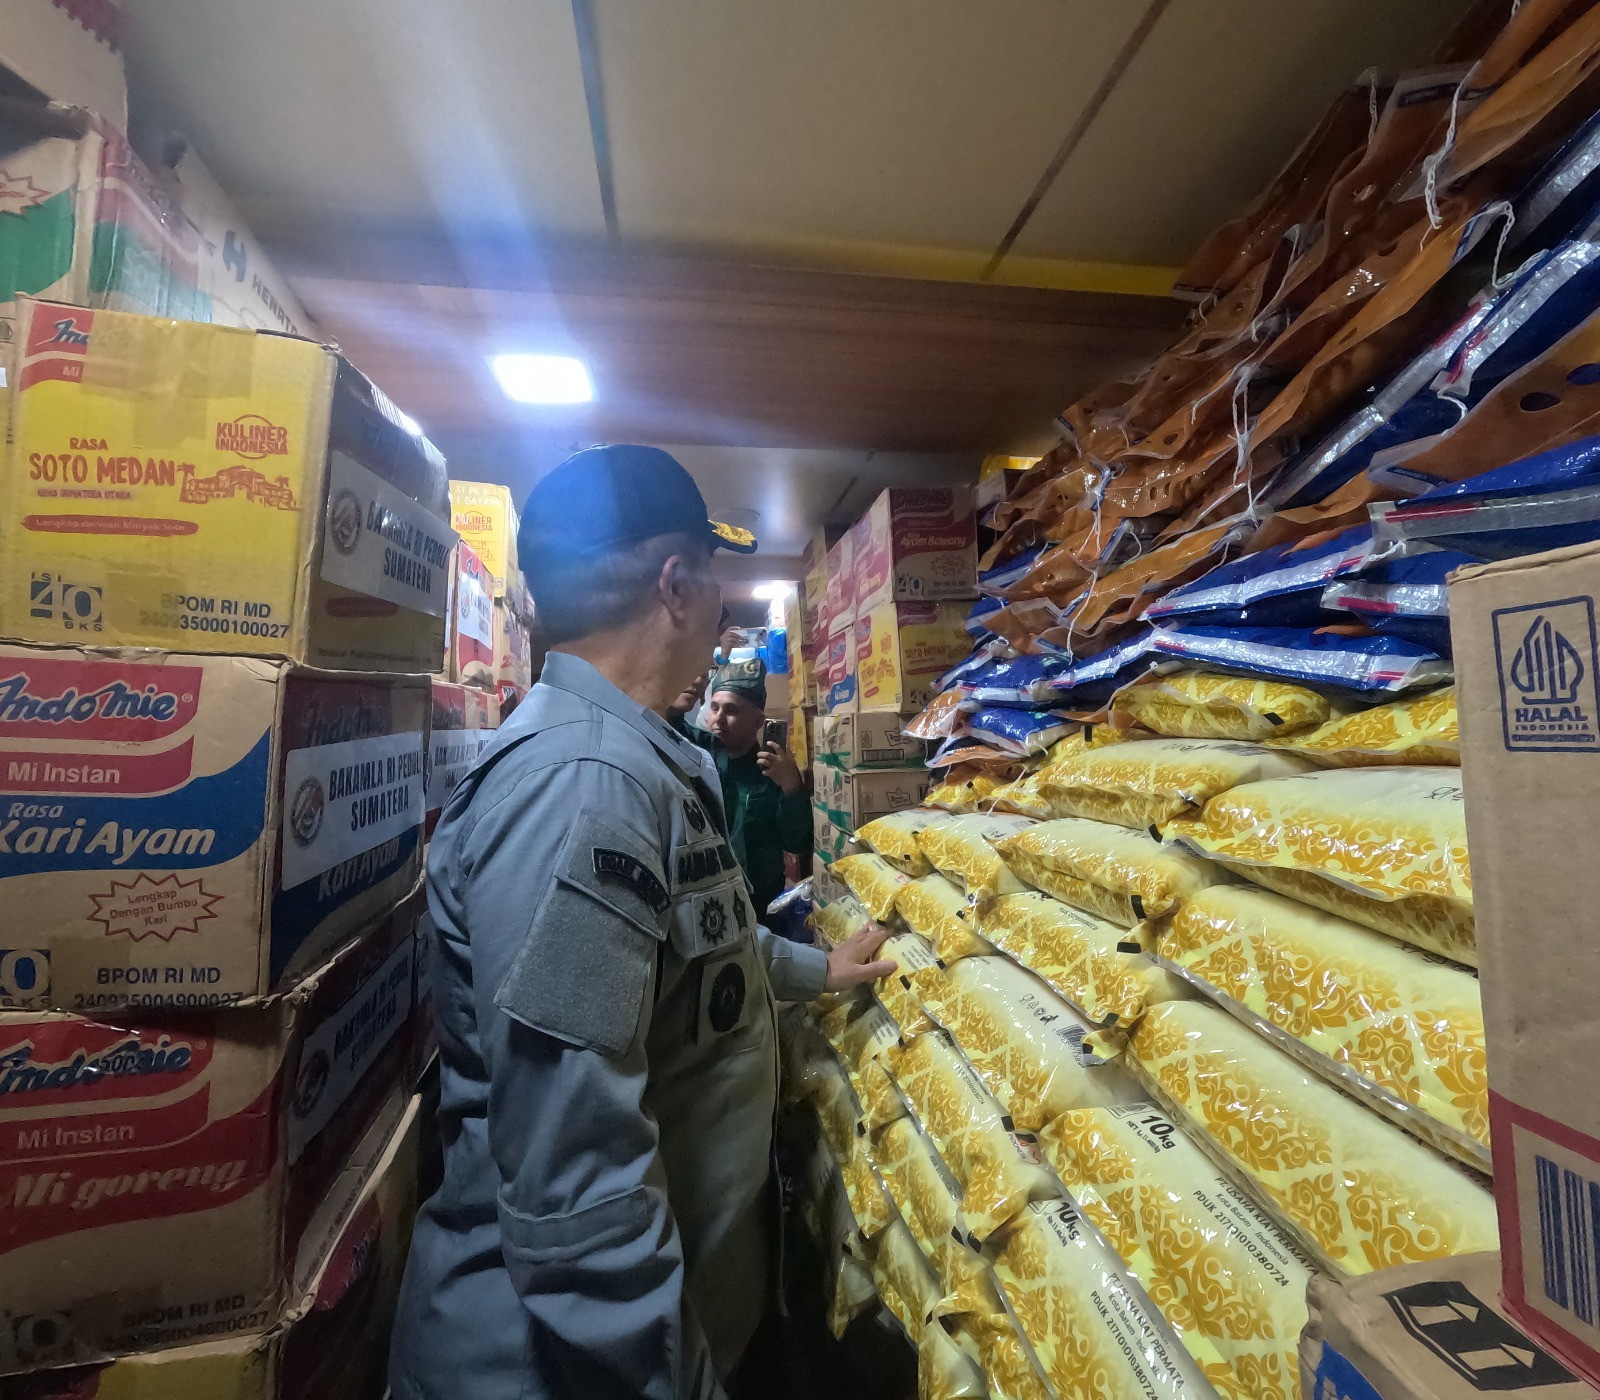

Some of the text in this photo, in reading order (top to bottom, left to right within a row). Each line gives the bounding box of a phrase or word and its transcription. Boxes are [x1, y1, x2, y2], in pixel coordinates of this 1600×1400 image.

[69, 437, 109, 451] RASA
[215, 437, 289, 455] INDONESIA
[216, 421, 288, 443] KULINER
[28, 452, 176, 487] SOTO MEDAN
[383, 546, 432, 593] SUMATERA
[29, 579, 104, 623] 40
[220, 599, 239, 616] RI
[243, 601, 272, 619] MD
[1515, 706, 1588, 723] HALAL
[7, 761, 121, 784] Mi Instan
[328, 758, 384, 801] BAKAMLA
[386, 756, 396, 784] RI
[8, 802, 64, 819] Rasa
[350, 784, 410, 832] SUMATERA
[84, 821, 216, 865] Ayam
[109, 898, 198, 920] Dengan Bumbu
[127, 889, 178, 904] Lengkap
[144, 913, 168, 926] Kari
[97, 966, 221, 985] BPOM RI MD
[18, 1123, 136, 1151] Mi Instan
[13, 1159, 247, 1210] Mi goreng
[1193, 1189, 1218, 1213] PDUK
[1214, 1176, 1320, 1276] PT. USAHA KIAT PERMATA
[1215, 1192, 1232, 1208] Kota
[1230, 1206, 1252, 1228] Batam
[1254, 1231, 1290, 1266] Indonesia
[1090, 1290, 1110, 1319] PDUK
[1107, 1293, 1121, 1313] Kota
[1118, 1310, 1136, 1337] Batam
[1150, 1337, 1185, 1390] PERMATA
